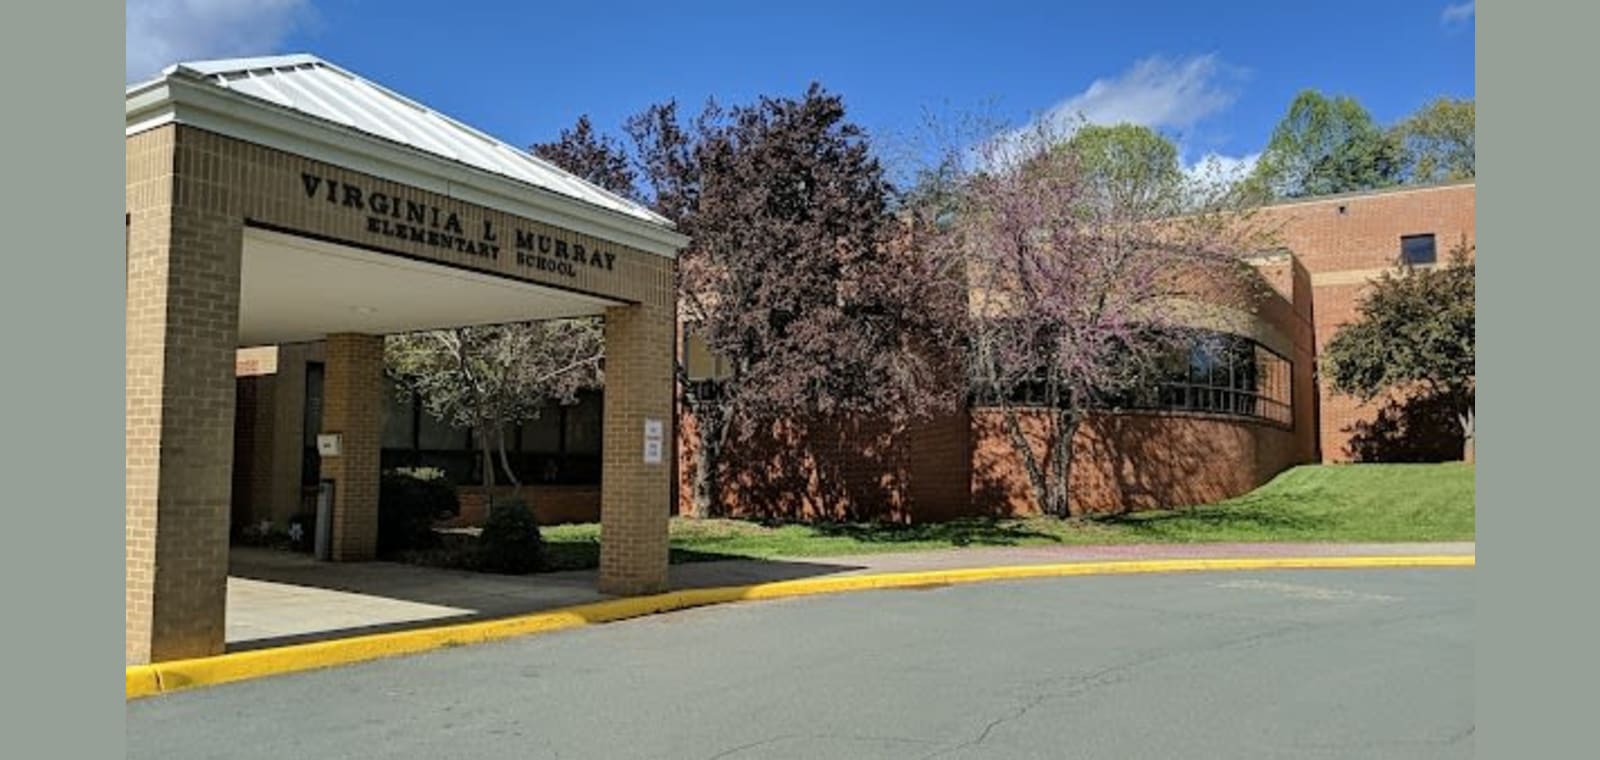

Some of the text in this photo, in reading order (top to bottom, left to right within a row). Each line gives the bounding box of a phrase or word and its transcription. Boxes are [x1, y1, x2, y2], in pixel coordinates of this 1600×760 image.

[301, 173, 616, 271] VIRGINIA L MURRAY
[367, 217, 577, 277] ELEMENTARY SCHOOL
